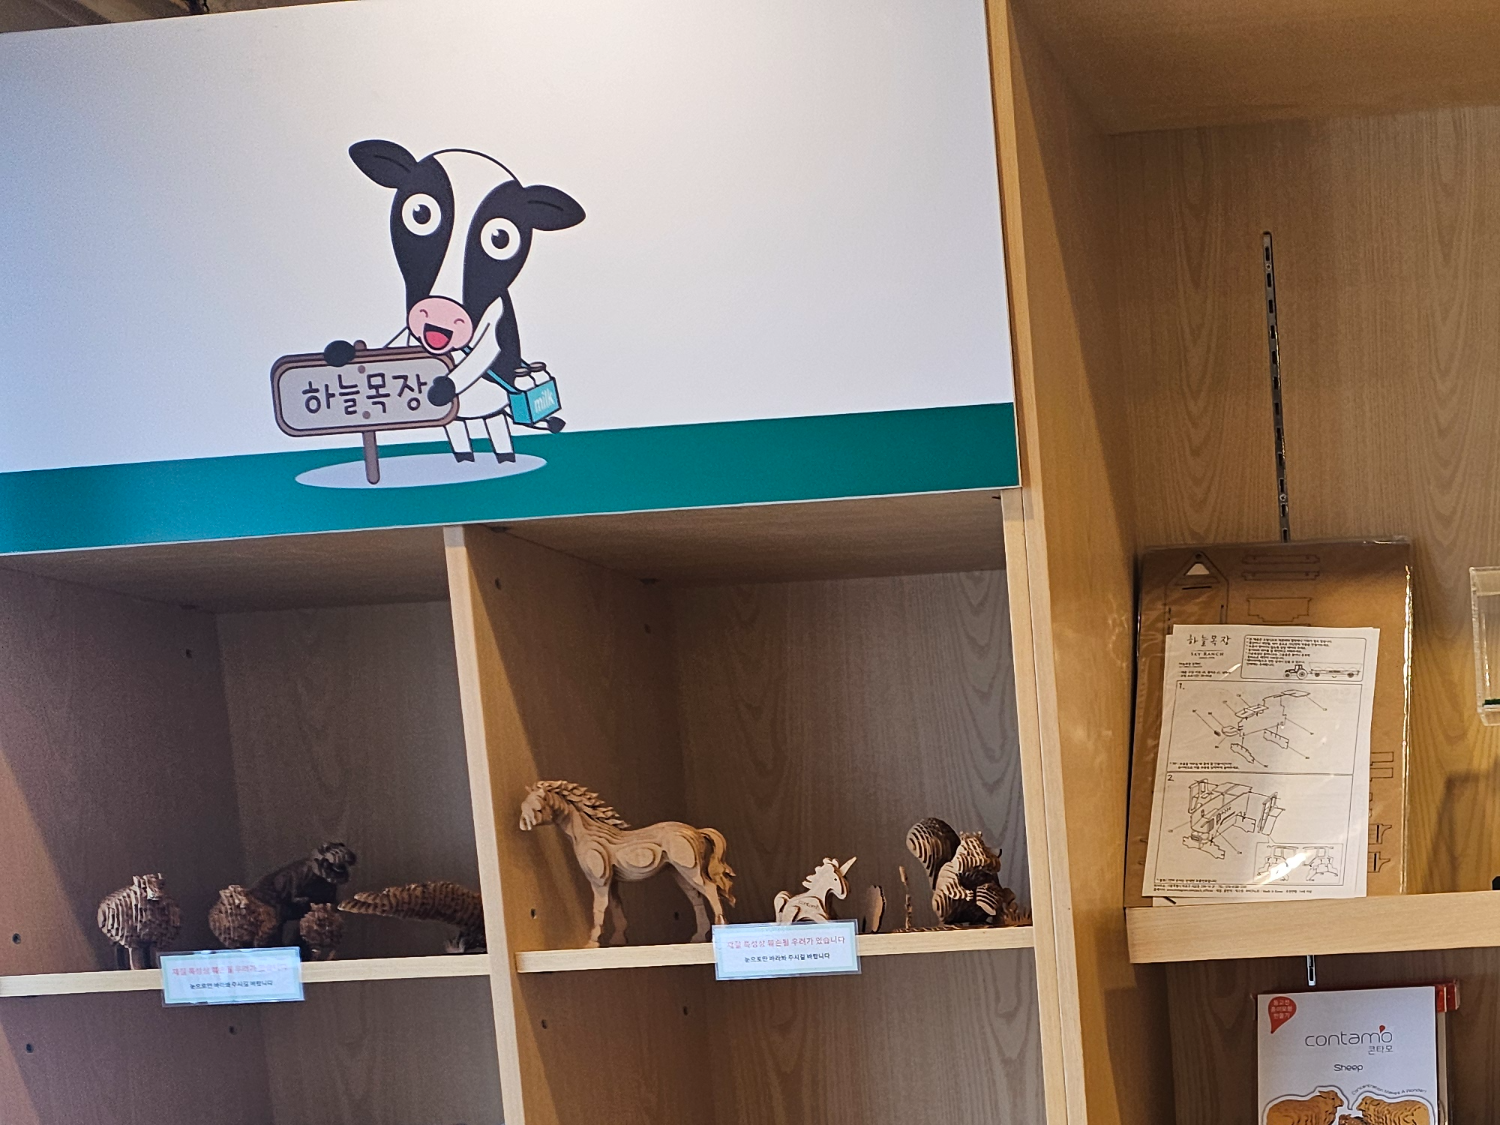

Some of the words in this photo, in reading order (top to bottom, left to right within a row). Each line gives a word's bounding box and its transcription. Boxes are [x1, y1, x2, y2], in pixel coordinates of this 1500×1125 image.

[301, 372, 428, 415] 하늘목장
[533, 388, 559, 415] milk
[1186, 633, 1232, 647] 하늘목장
[815, 935, 845, 945] 있습니다
[806, 952, 830, 960] 바랍니다
[1305, 1031, 1393, 1047] contamo
[1368, 1045, 1394, 1055] 콘타모
[1333, 1063, 1364, 1073] Sheep
